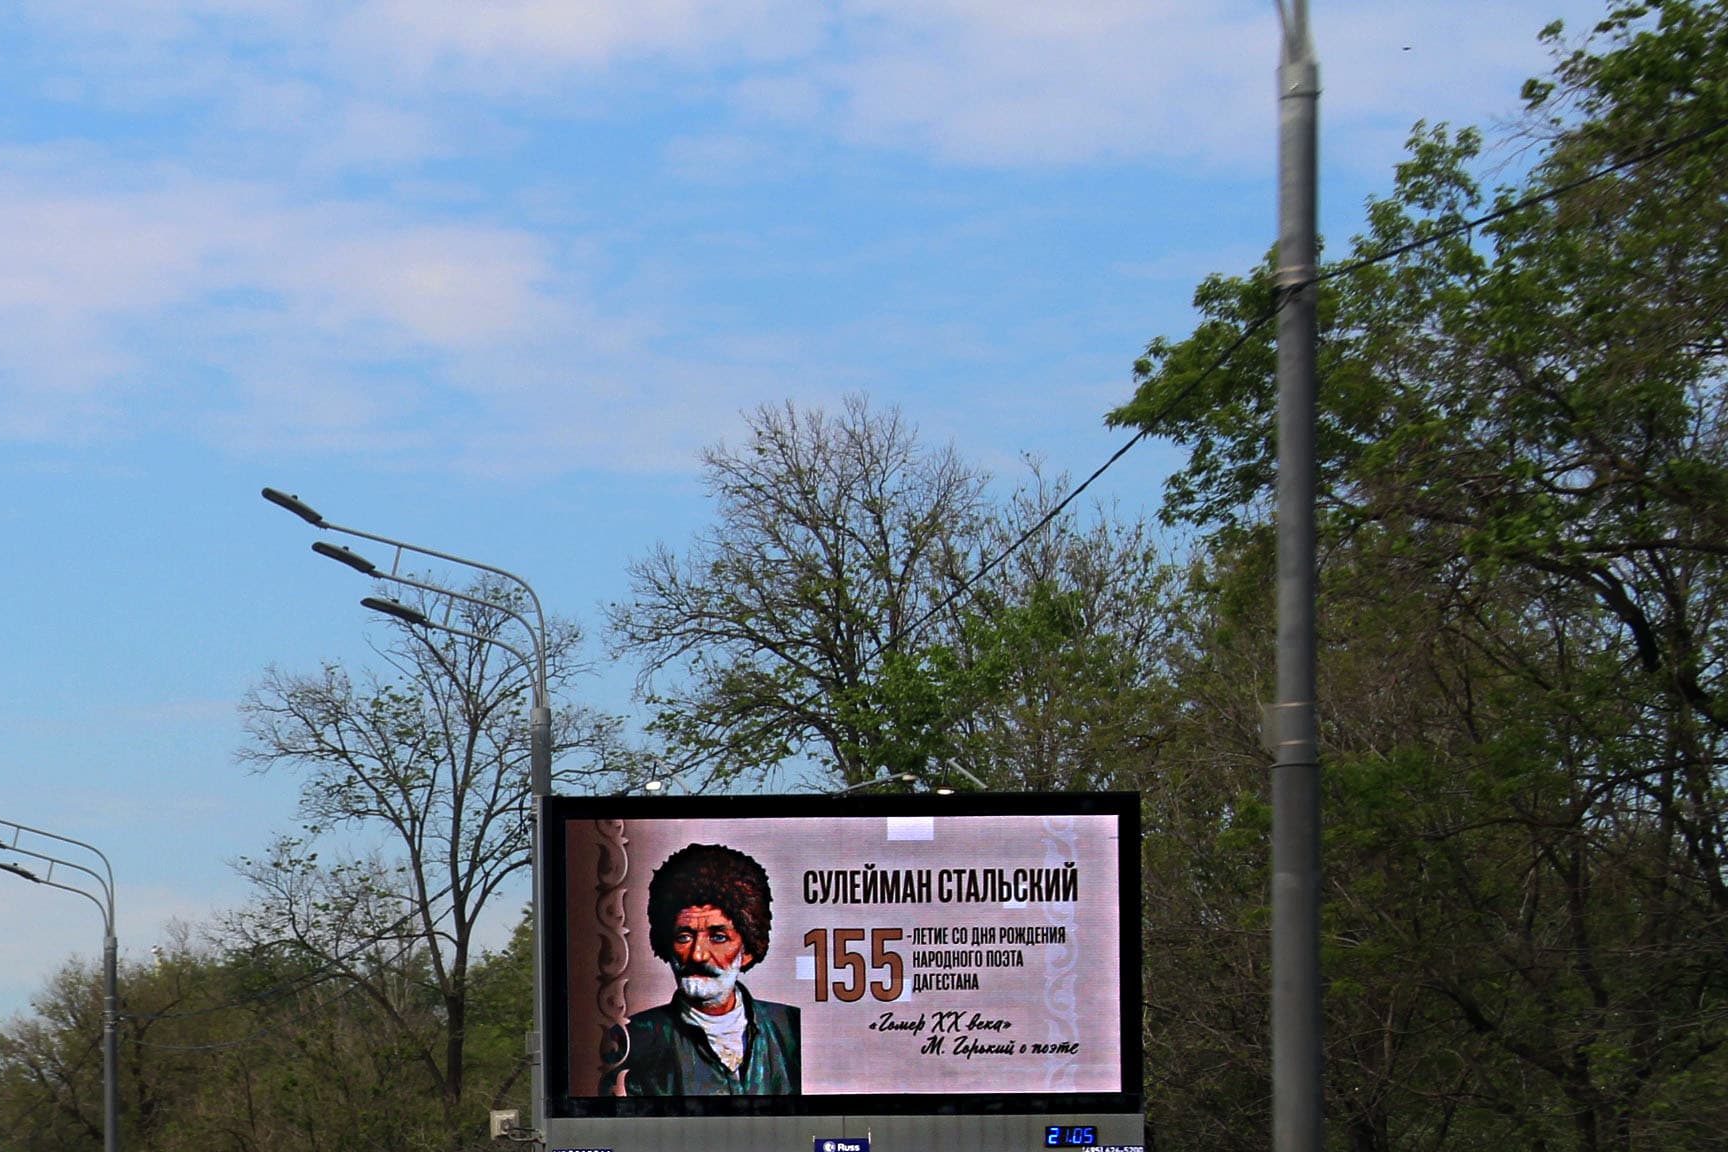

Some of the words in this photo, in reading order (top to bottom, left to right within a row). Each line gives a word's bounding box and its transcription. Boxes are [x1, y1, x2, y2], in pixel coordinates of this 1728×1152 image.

[803, 863, 932, 905] СУЛЕЙМАН
[937, 861, 1079, 903] СТАЛЬСКИЙ
[906, 928, 949, 946] -ЛЕТИЕ
[951, 928, 968, 945] СО
[972, 928, 996, 947] ДНЯ
[999, 927, 1066, 947] РОЖДЕНИЯ
[803, 927, 905, 1003] 155
[912, 951, 983, 970] НАРОДНОГО
[986, 951, 1024, 969] ПОЭТА
[912, 973, 979, 993] ДАГЕСТАНА
[868, 1012, 925, 1033] «Гомер
[966, 1012, 1012, 1031] века»
[921, 1036, 945, 1055] М.
[952, 1036, 1015, 1056] Горький
[1019, 1045, 1027, 1055] о
[1031, 1042, 1079, 1055] поэте
[1048, 1127, 1094, 1144] 21.05
[837, 1143, 860, 1152] Russ
